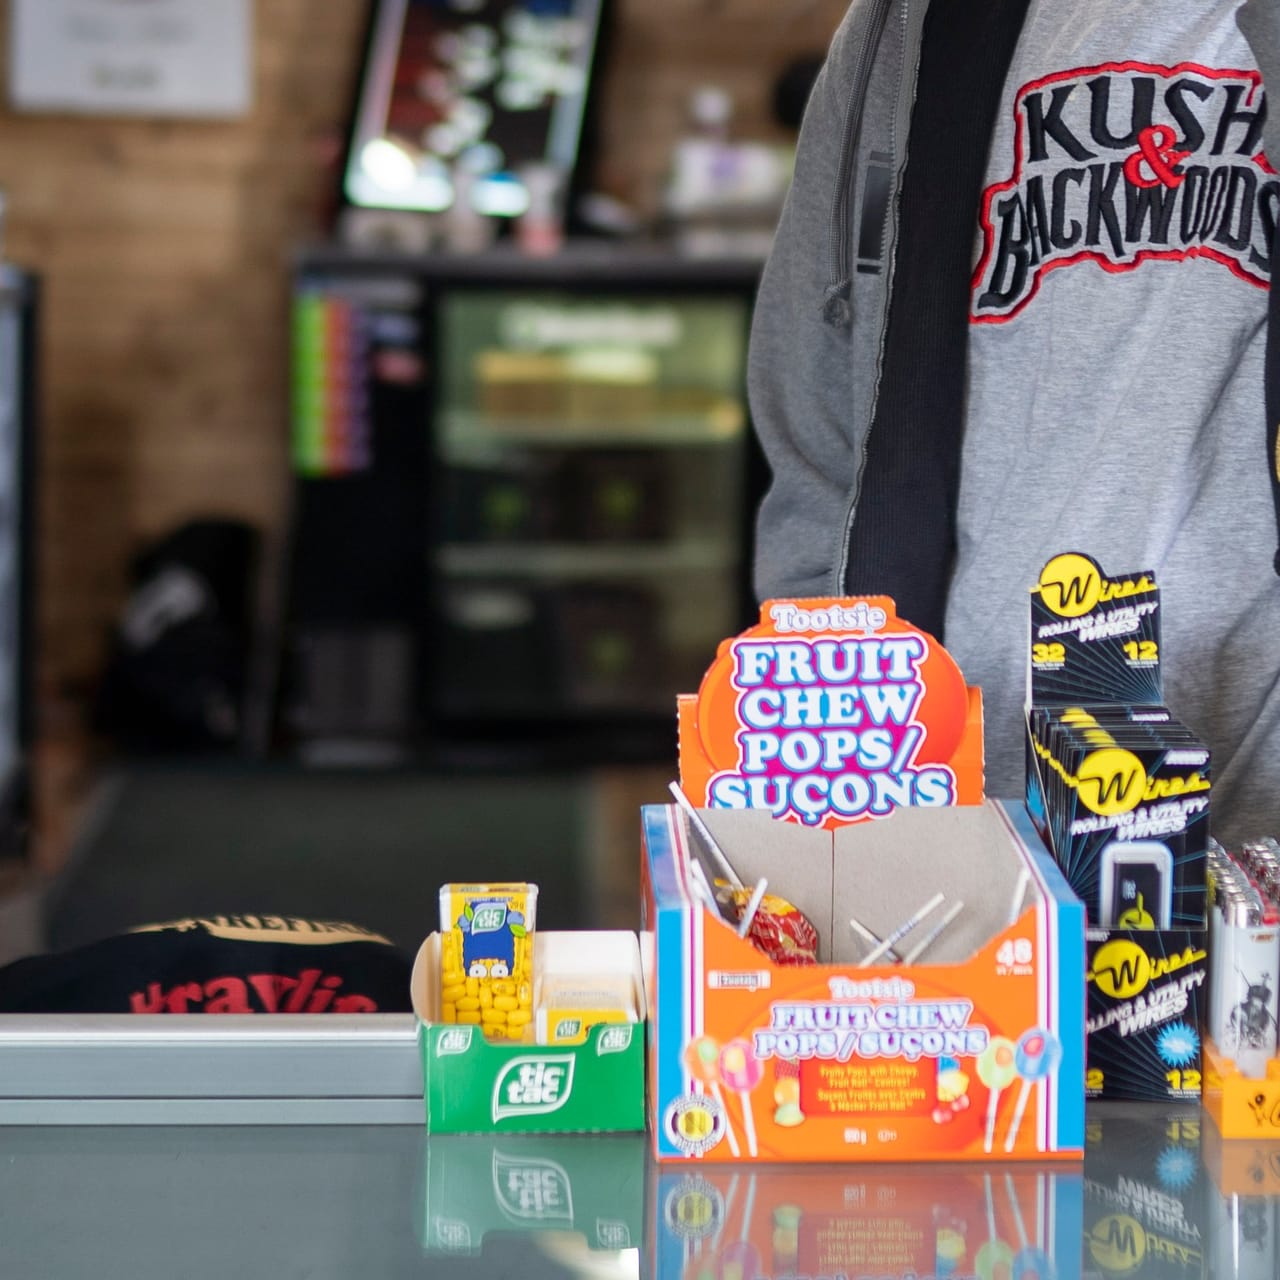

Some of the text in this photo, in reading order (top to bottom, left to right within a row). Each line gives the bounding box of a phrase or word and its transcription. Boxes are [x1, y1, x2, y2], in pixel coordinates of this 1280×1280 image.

[1021, 76, 1267, 164] KUSH
[1123, 124, 1191, 188] &
[771, 603, 886, 633] Tootsie
[1038, 615, 1094, 638] ROLLING
[1106, 601, 1159, 623] UTILITY
[1078, 619, 1140, 643] WIRES
[736, 638, 925, 685] FRUIT
[1032, 640, 1159, 663] 32 12
[741, 685, 922, 728] CHEW
[741, 726, 921, 776] POPS/
[711, 769, 954, 826] SUÇONS
[1070, 811, 1135, 836] ROLLING
[1149, 797, 1209, 820] UTILITY
[1117, 818, 1187, 842] WIRES
[997, 937, 1033, 966] 48
[830, 977, 915, 999] Tootsie
[1148, 968, 1206, 1012] UTILITY
[773, 1005, 971, 1030] FRUIT CHEW
[1120, 995, 1188, 1038] WIRES
[756, 1031, 838, 1058] POPS
[859, 1032, 989, 1060] SUÇONS
[519, 1062, 565, 1089] tic
[1086, 1068, 1202, 1091] 2 12
[507, 1081, 562, 1105] tac
